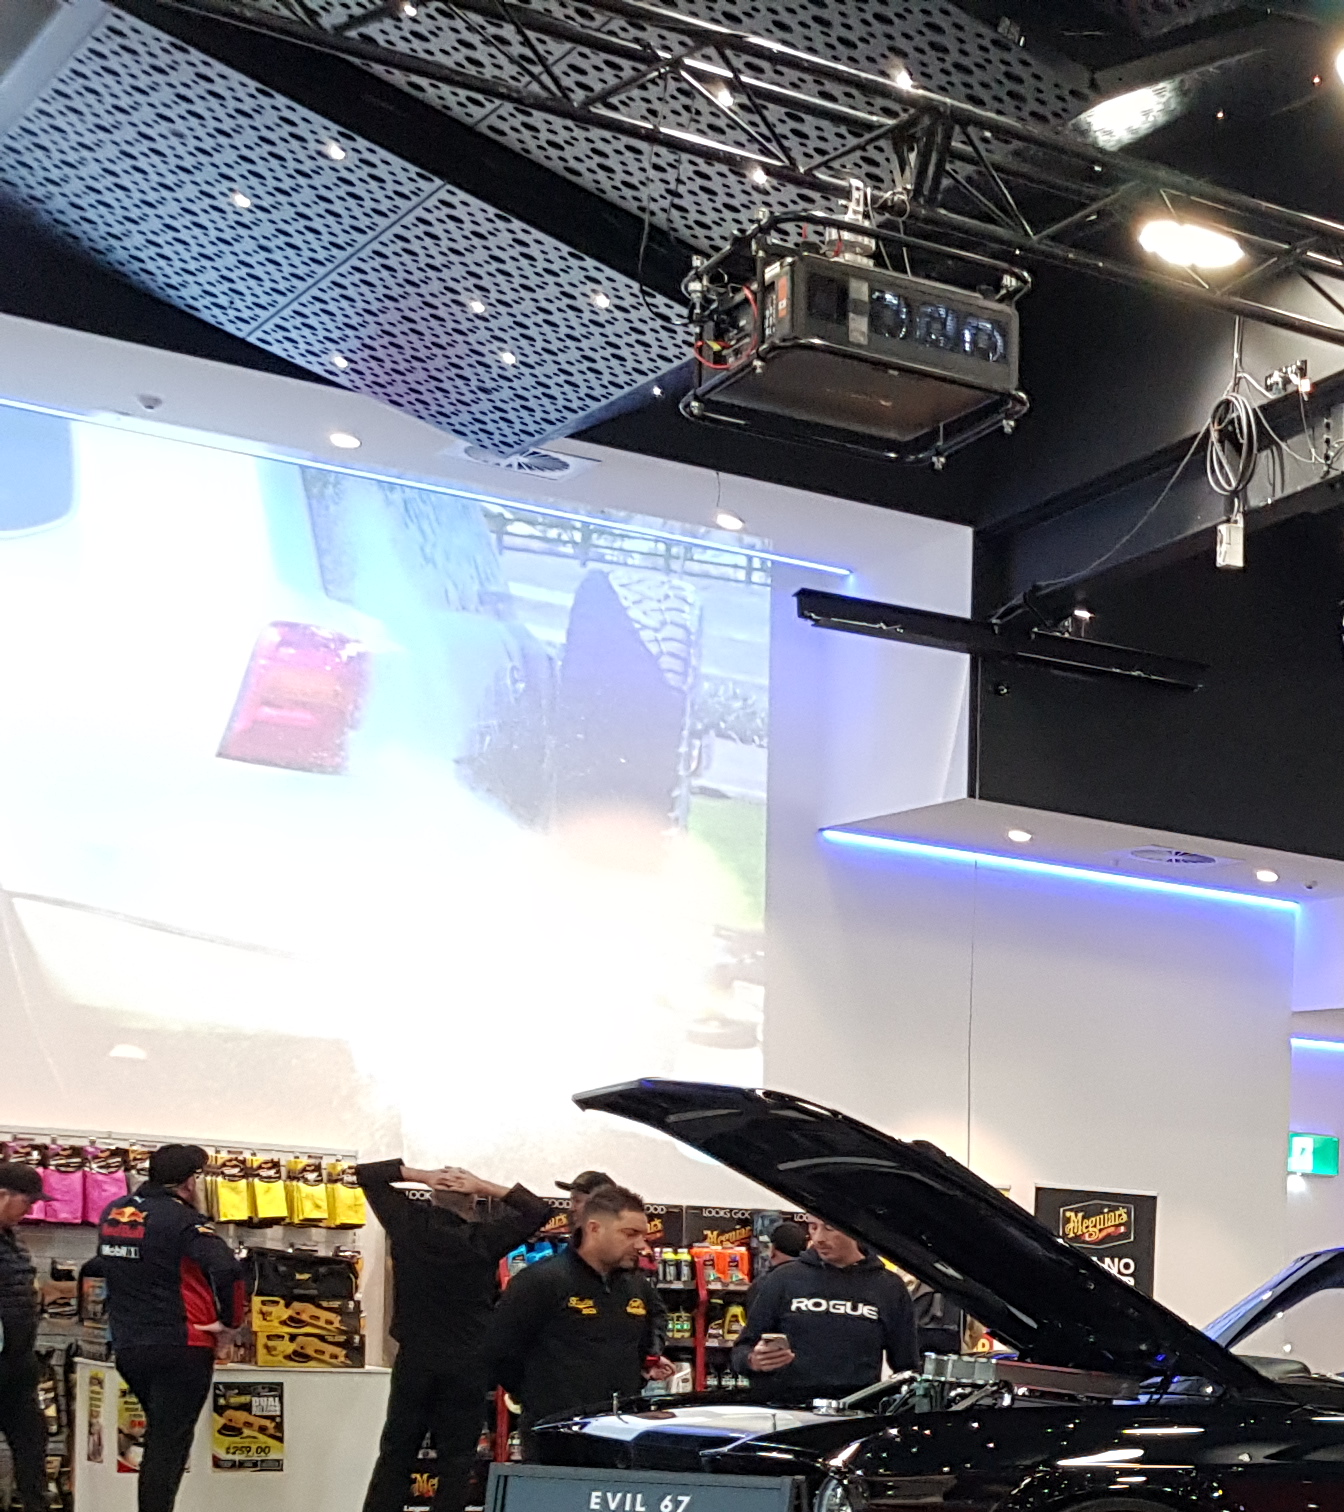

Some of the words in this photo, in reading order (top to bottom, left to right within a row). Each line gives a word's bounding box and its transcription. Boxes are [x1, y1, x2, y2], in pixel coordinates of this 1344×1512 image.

[702, 1208, 731, 1218] LOOKS
[1065, 1207, 1128, 1240] Meguiar's
[790, 1297, 879, 1320] ROGUE
